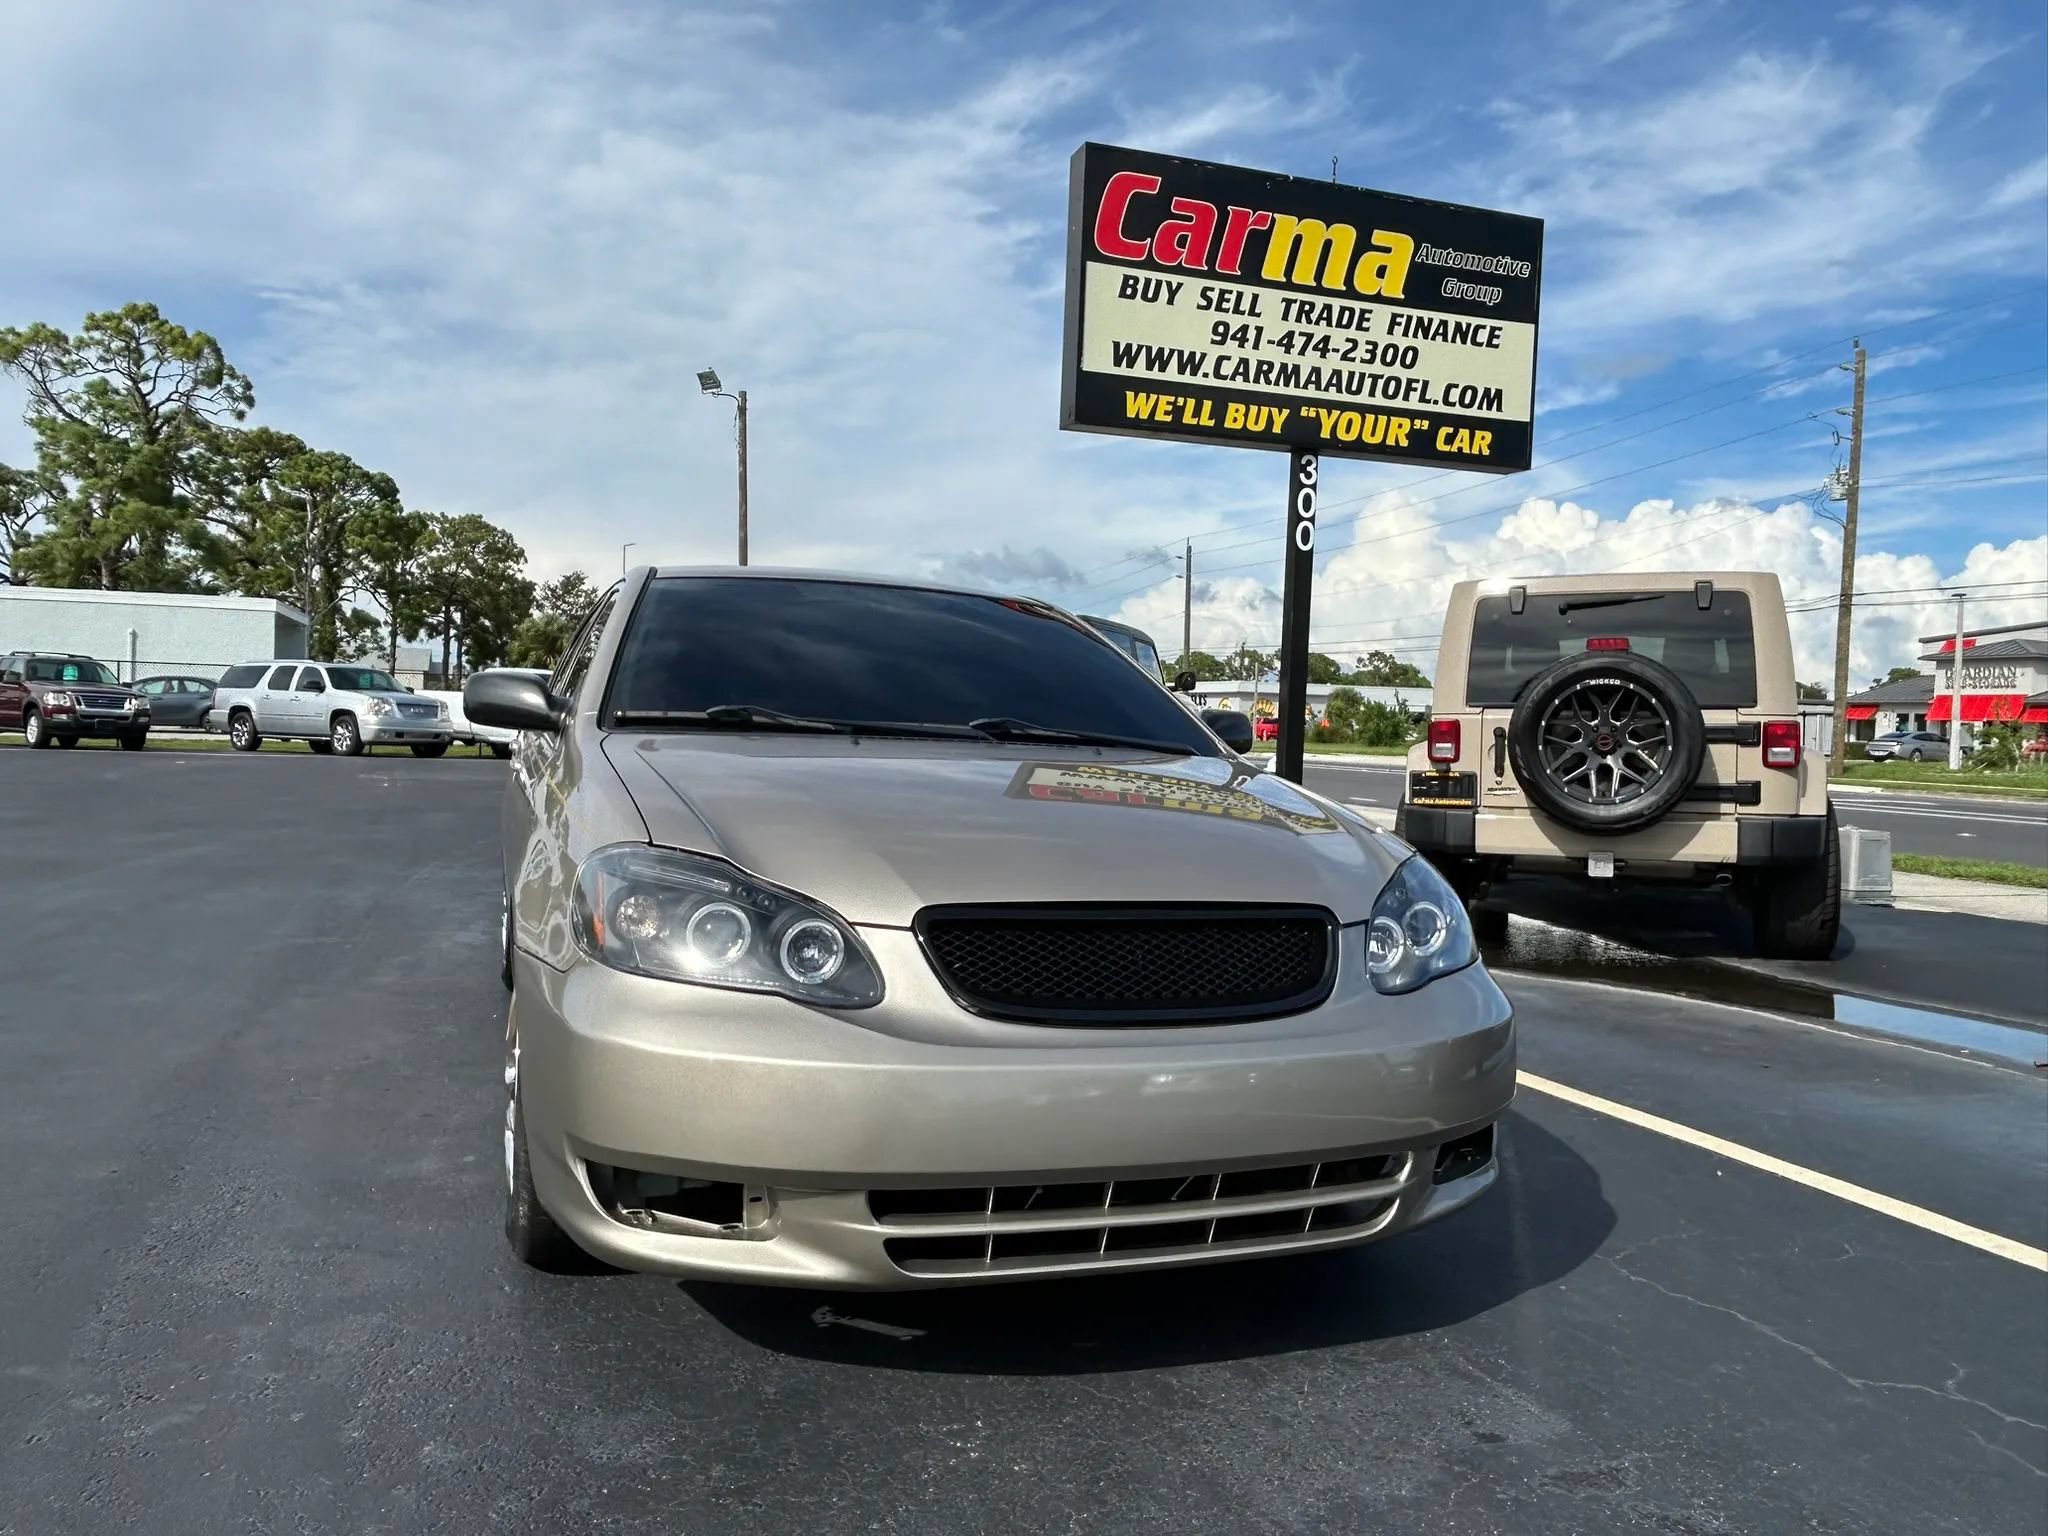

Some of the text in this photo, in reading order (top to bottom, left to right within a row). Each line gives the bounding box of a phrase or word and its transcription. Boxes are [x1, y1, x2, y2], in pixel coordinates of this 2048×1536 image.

[1094, 171, 1415, 299] Carma
[1415, 243, 1531, 278] Automotive
[1117, 274, 1504, 349] BUY SELL TRADE FINANCE
[1441, 277, 1502, 305] Group
[1111, 340, 1504, 413] WWW.CARMAAUTOFL.COM
[1210, 320, 1420, 370] 941-474-2300
[1125, 390, 1216, 427] WE'LL
[1223, 402, 1290, 434] BUY
[1435, 425, 1493, 456] CAR
[1295, 454, 1318, 551] 300
